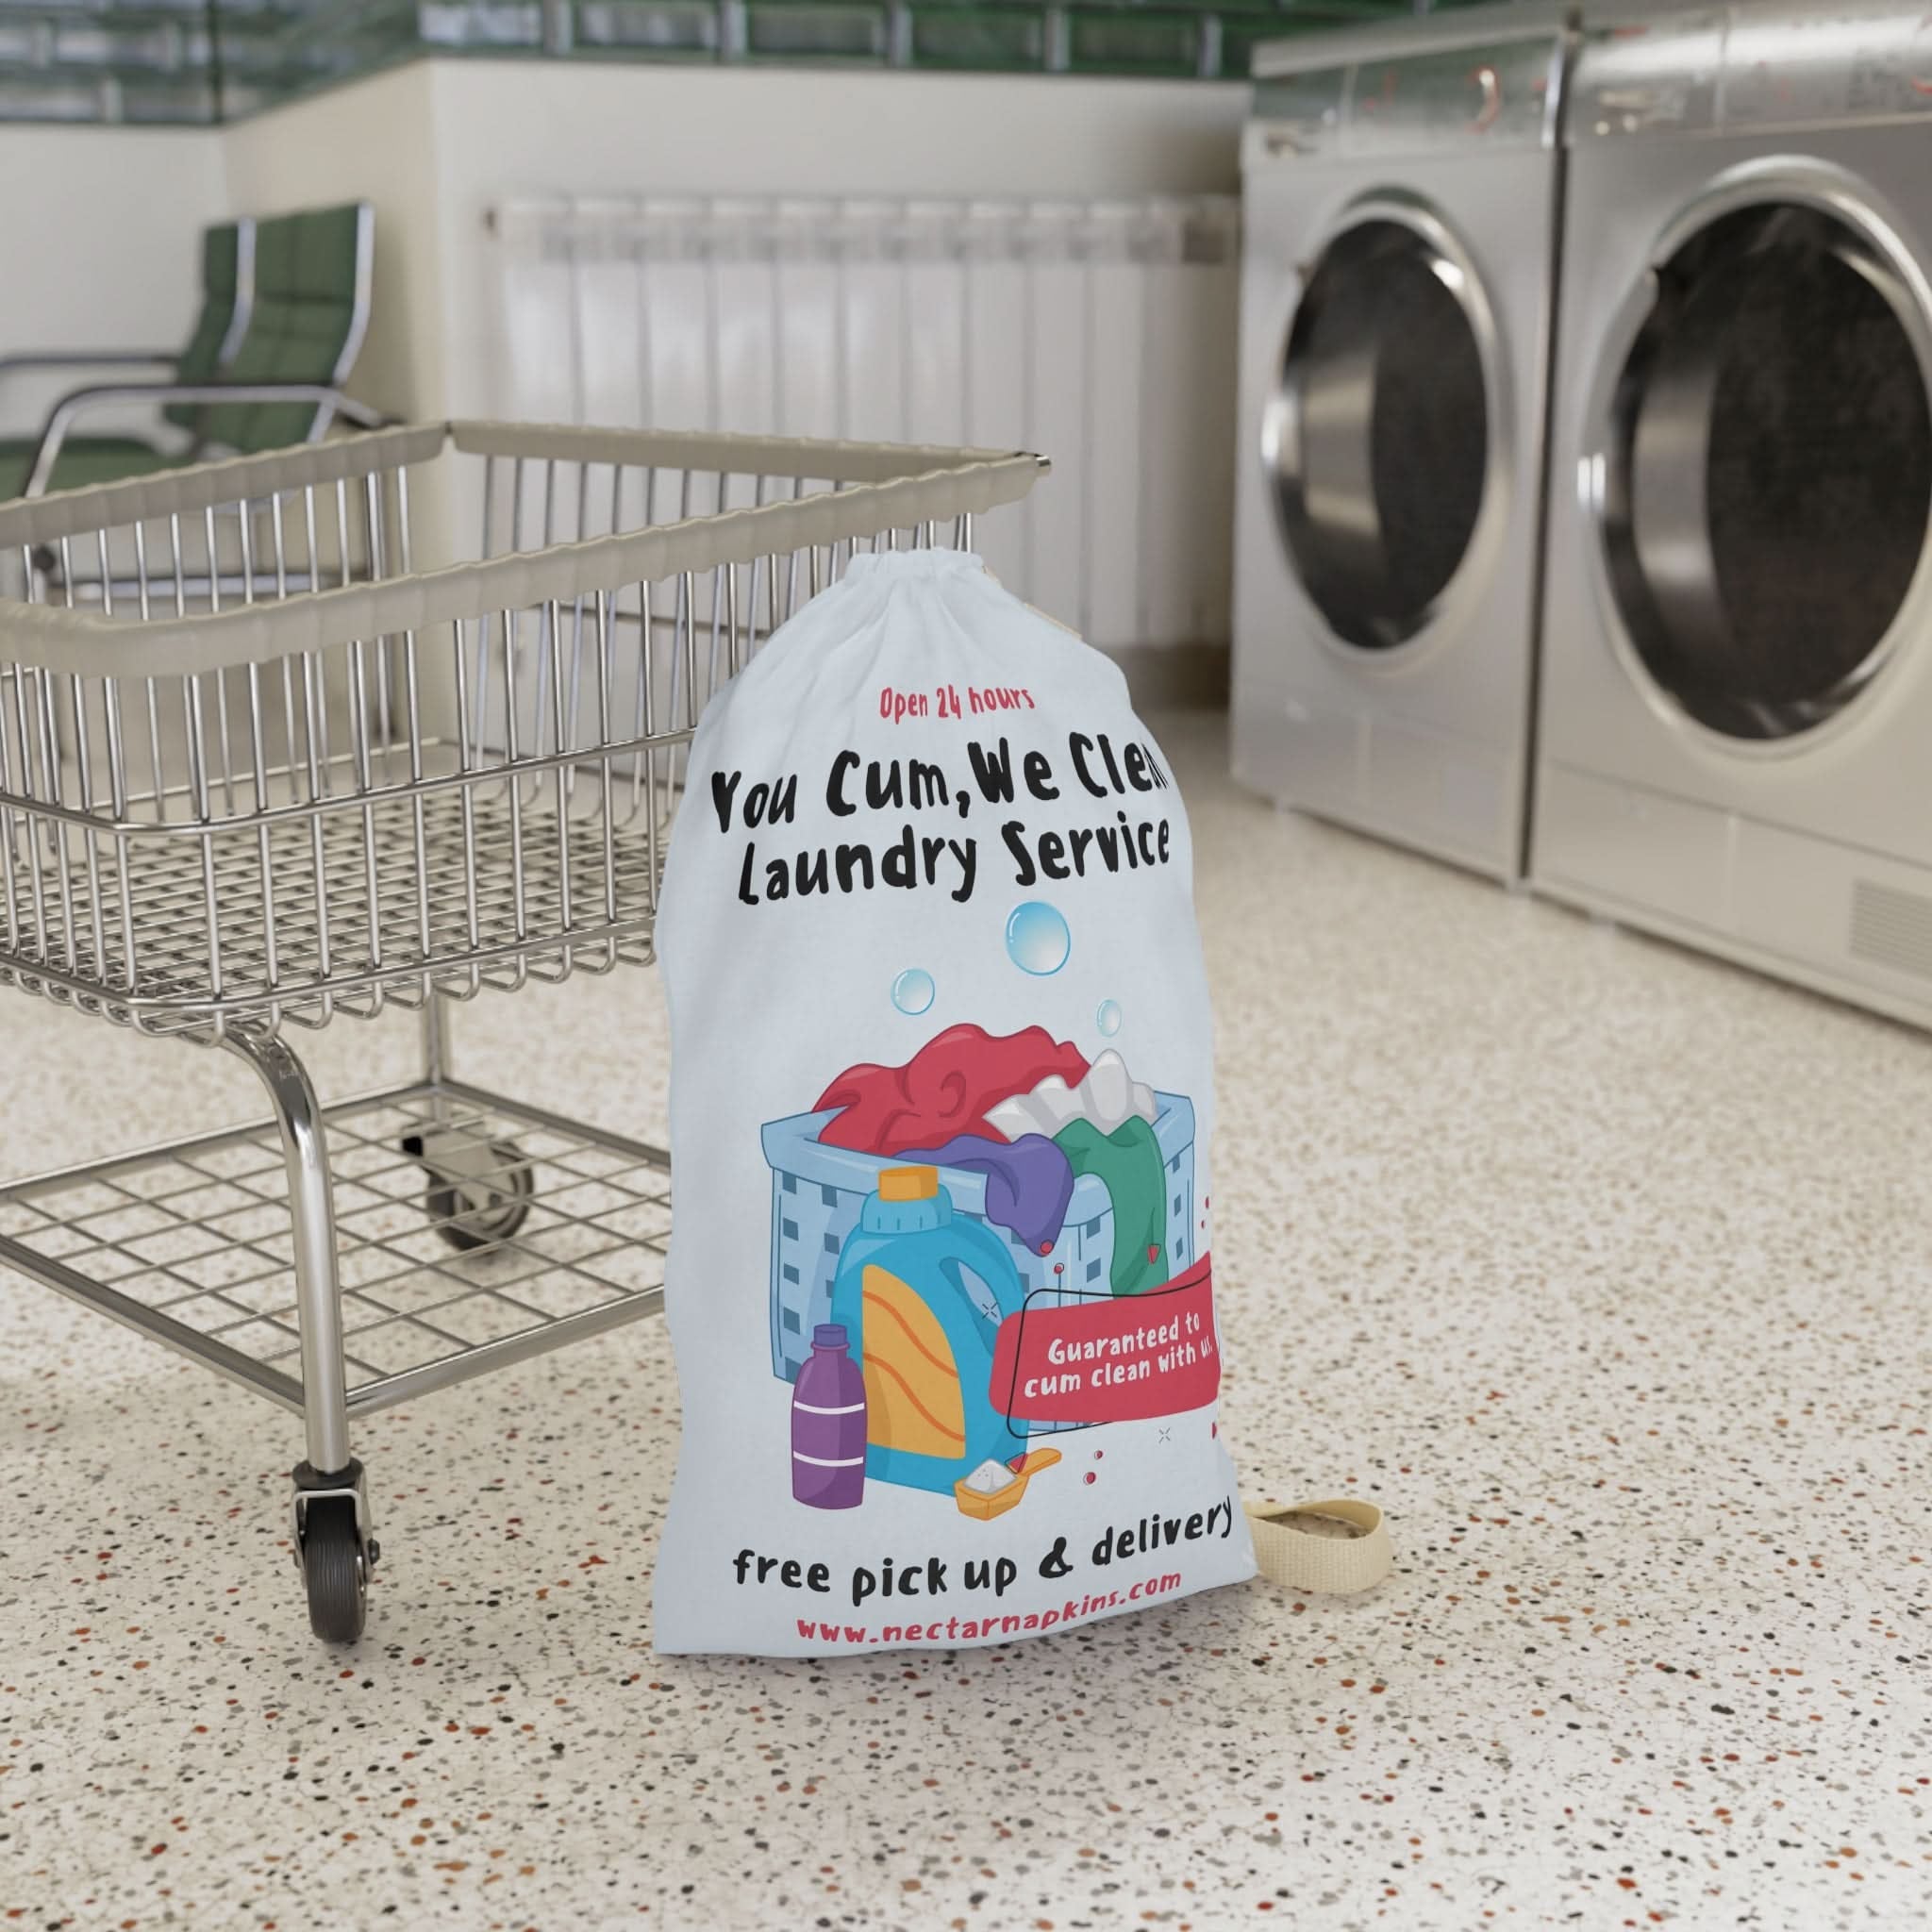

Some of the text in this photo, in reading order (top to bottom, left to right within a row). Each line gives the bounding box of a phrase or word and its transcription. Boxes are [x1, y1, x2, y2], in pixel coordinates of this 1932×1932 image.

[879, 685, 1035, 724] Open 24 hours
[710, 771, 797, 833] You
[738, 809, 1170, 905] Laundry Service
[1047, 1310, 1200, 1366] Guaranteed to
[1024, 1374, 1081, 1398] cum
[1091, 1358, 1150, 1388] clean
[1158, 1341, 1196, 1373] with
[732, 1495, 1232, 1607] free pick up & delivery
[796, 1572, 1182, 1644] www.nectarnapkins.com
